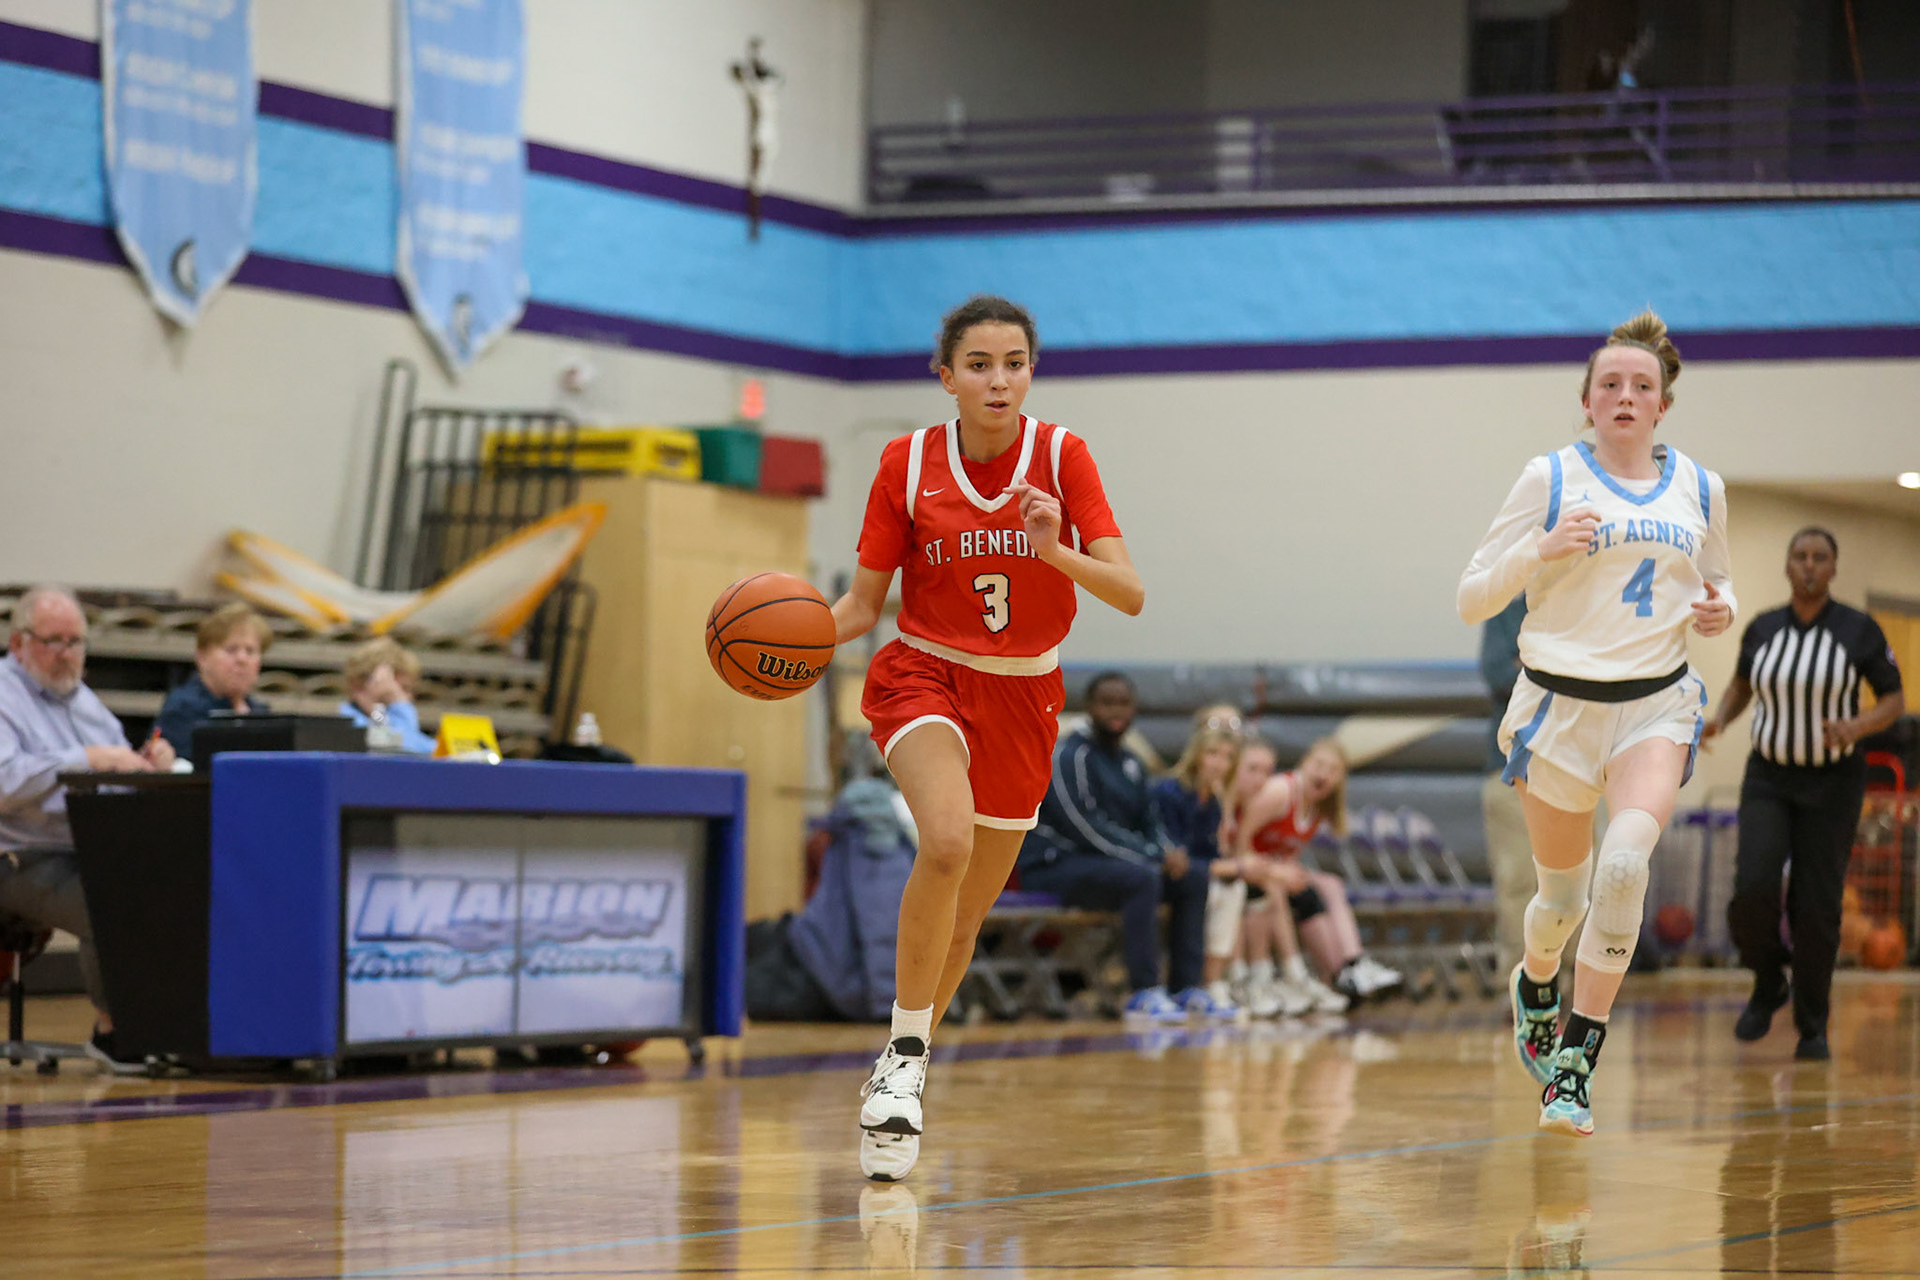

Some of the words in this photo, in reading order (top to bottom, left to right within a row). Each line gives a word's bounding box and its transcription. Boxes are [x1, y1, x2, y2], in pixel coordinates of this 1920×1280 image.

[925, 538, 952, 566] ST.
[960, 529, 1041, 559] BENED
[1623, 518, 1694, 557] AGNES
[972, 573, 1010, 634] 3
[1621, 558, 1656, 617] 4
